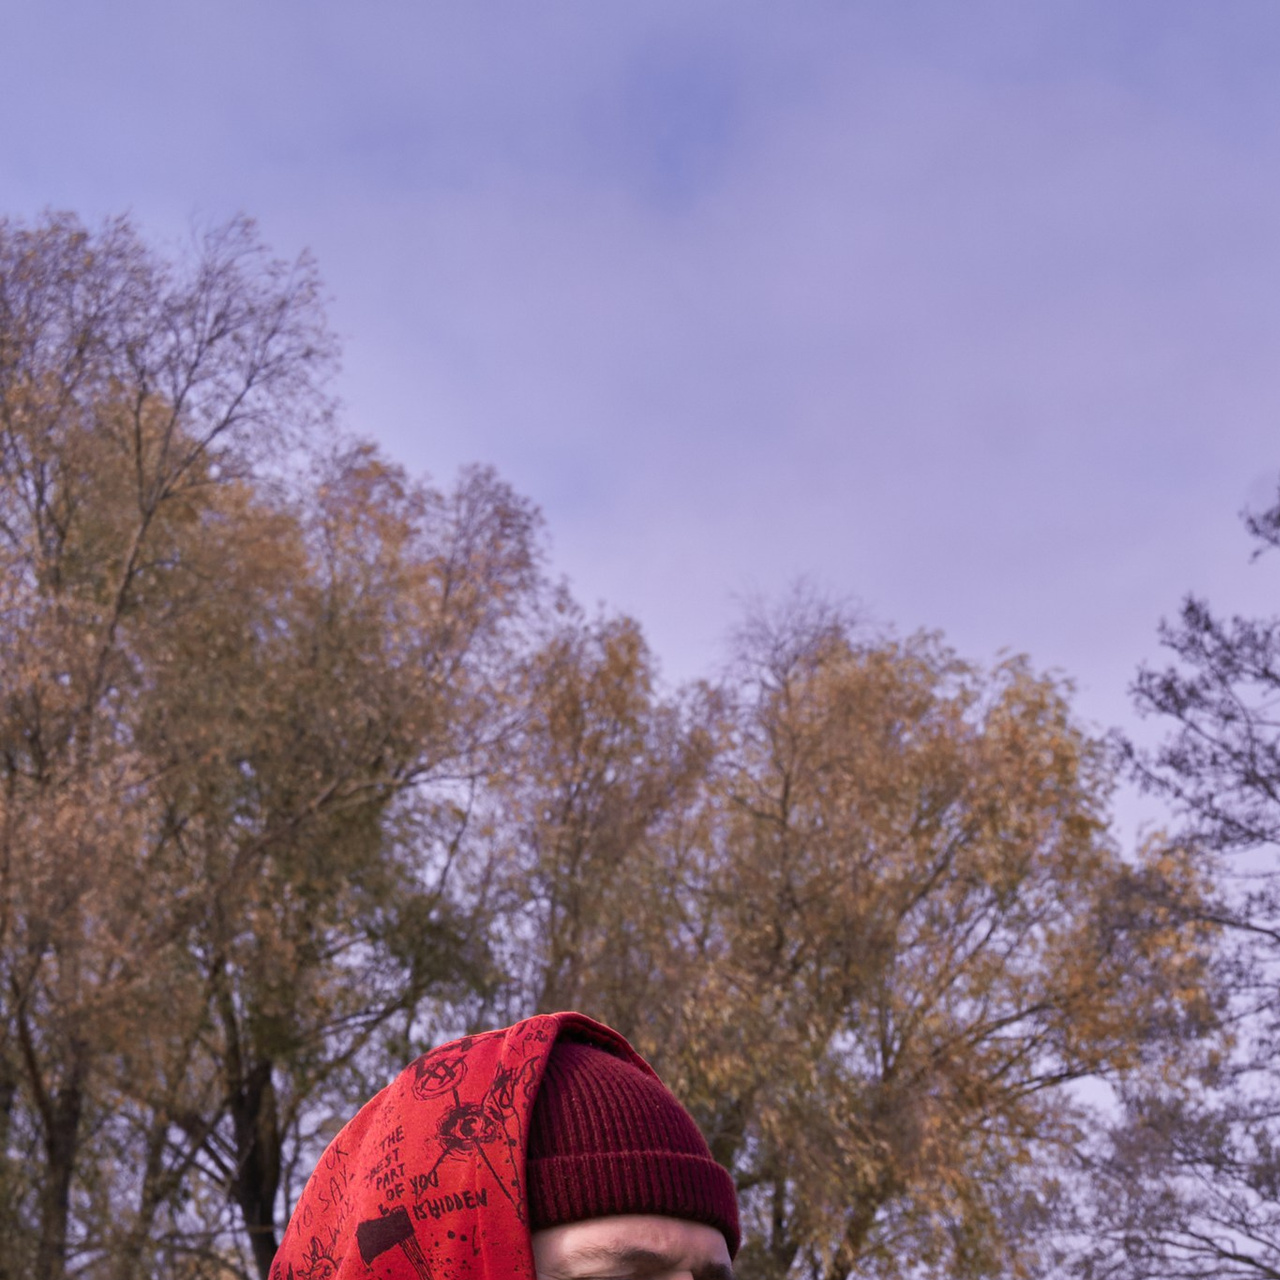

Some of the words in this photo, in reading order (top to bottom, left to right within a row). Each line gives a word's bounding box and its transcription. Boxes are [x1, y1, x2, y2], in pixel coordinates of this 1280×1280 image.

[380, 1125, 405, 1153] THE
[376, 1163, 406, 1190] PART
[386, 1182, 405, 1202] OF
[410, 1169, 439, 1200] YOU
[427, 1188, 488, 1220] HIDDEN
